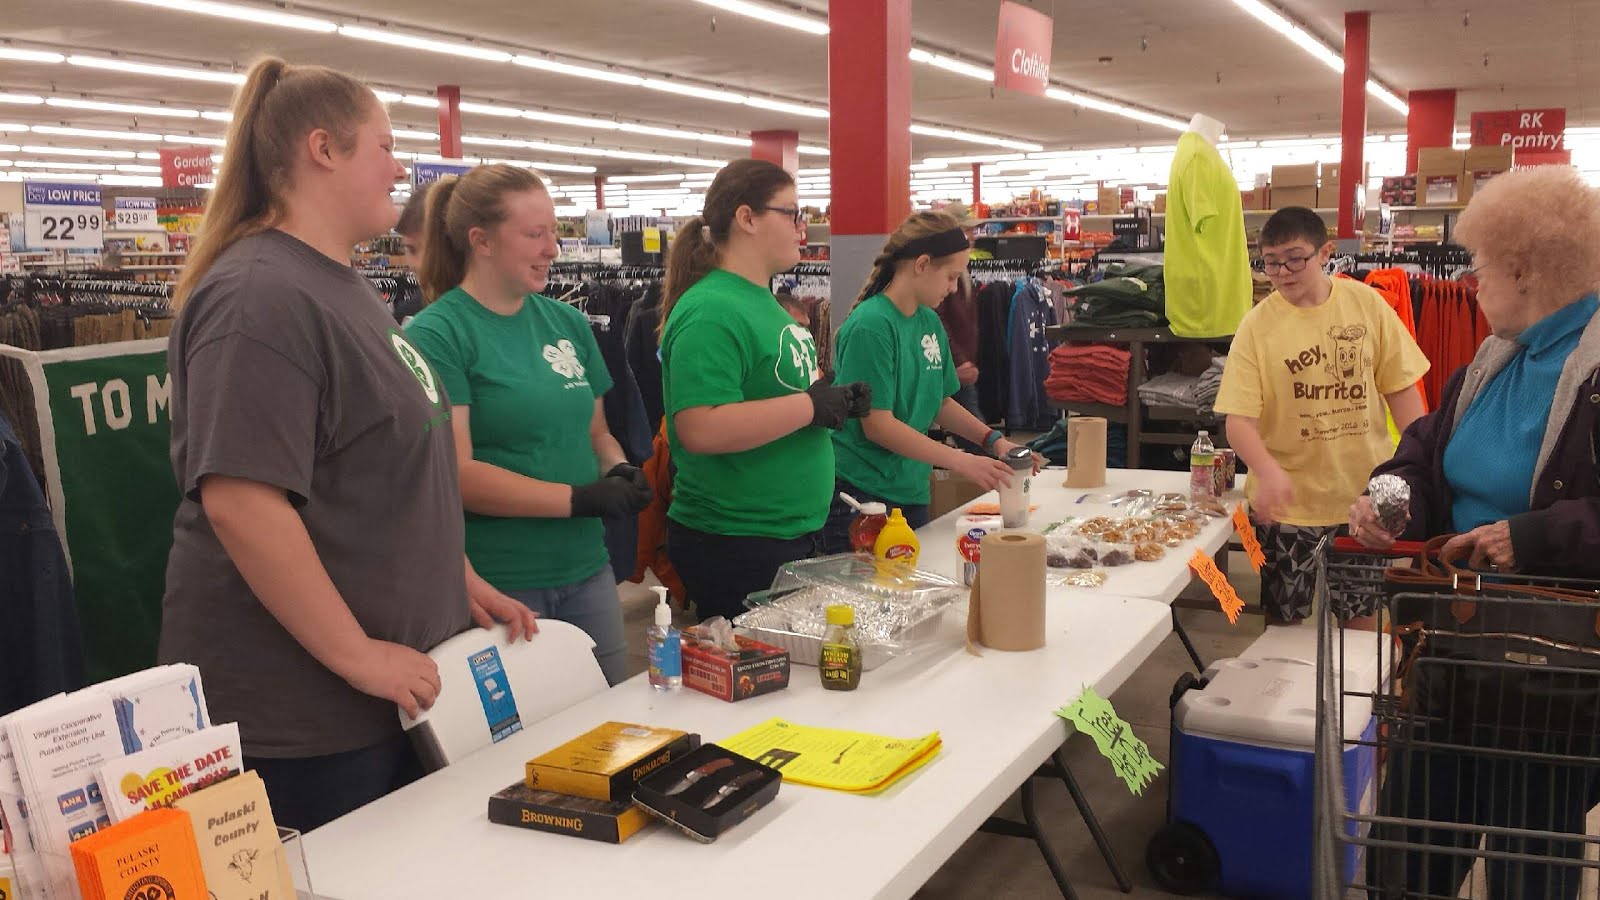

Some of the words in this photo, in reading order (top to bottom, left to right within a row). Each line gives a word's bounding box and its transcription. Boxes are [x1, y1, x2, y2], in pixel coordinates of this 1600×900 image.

[1011, 47, 1049, 87] Clothing
[1519, 112, 1545, 129] RK
[1500, 131, 1562, 150] Pantry
[173, 155, 212, 169] Garden
[417, 166, 435, 177] Every
[27, 184, 46, 194] Every
[177, 173, 212, 186] Center
[28, 192, 46, 203] Day
[48, 189, 71, 202] LOW
[73, 190, 101, 203] PRICE
[1284, 345, 1327, 374] hey,
[1293, 381, 1367, 400] Burrito!
[70, 378, 132, 436] TO
[33, 727, 60, 741] Virginia
[60, 713, 103, 732] Cooperative
[53, 727, 88, 744] Extension
[1078, 708, 1121, 742] Free
[39, 744, 65, 758] Pulaski
[65, 737, 90, 750] County
[91, 730, 106, 741] Unit
[127, 777, 165, 805] SAVE
[163, 763, 195, 786] THE
[193, 745, 233, 771] DATE
[632, 750, 671, 782] BROWNING
[164, 782, 195, 805] CAMP
[207, 801, 256, 830] Pulaski
[521, 809, 583, 832] BROWNING
[214, 820, 260, 847] County
[116, 843, 160, 867] PULASKI
[120, 856, 161, 879] COUNTY
